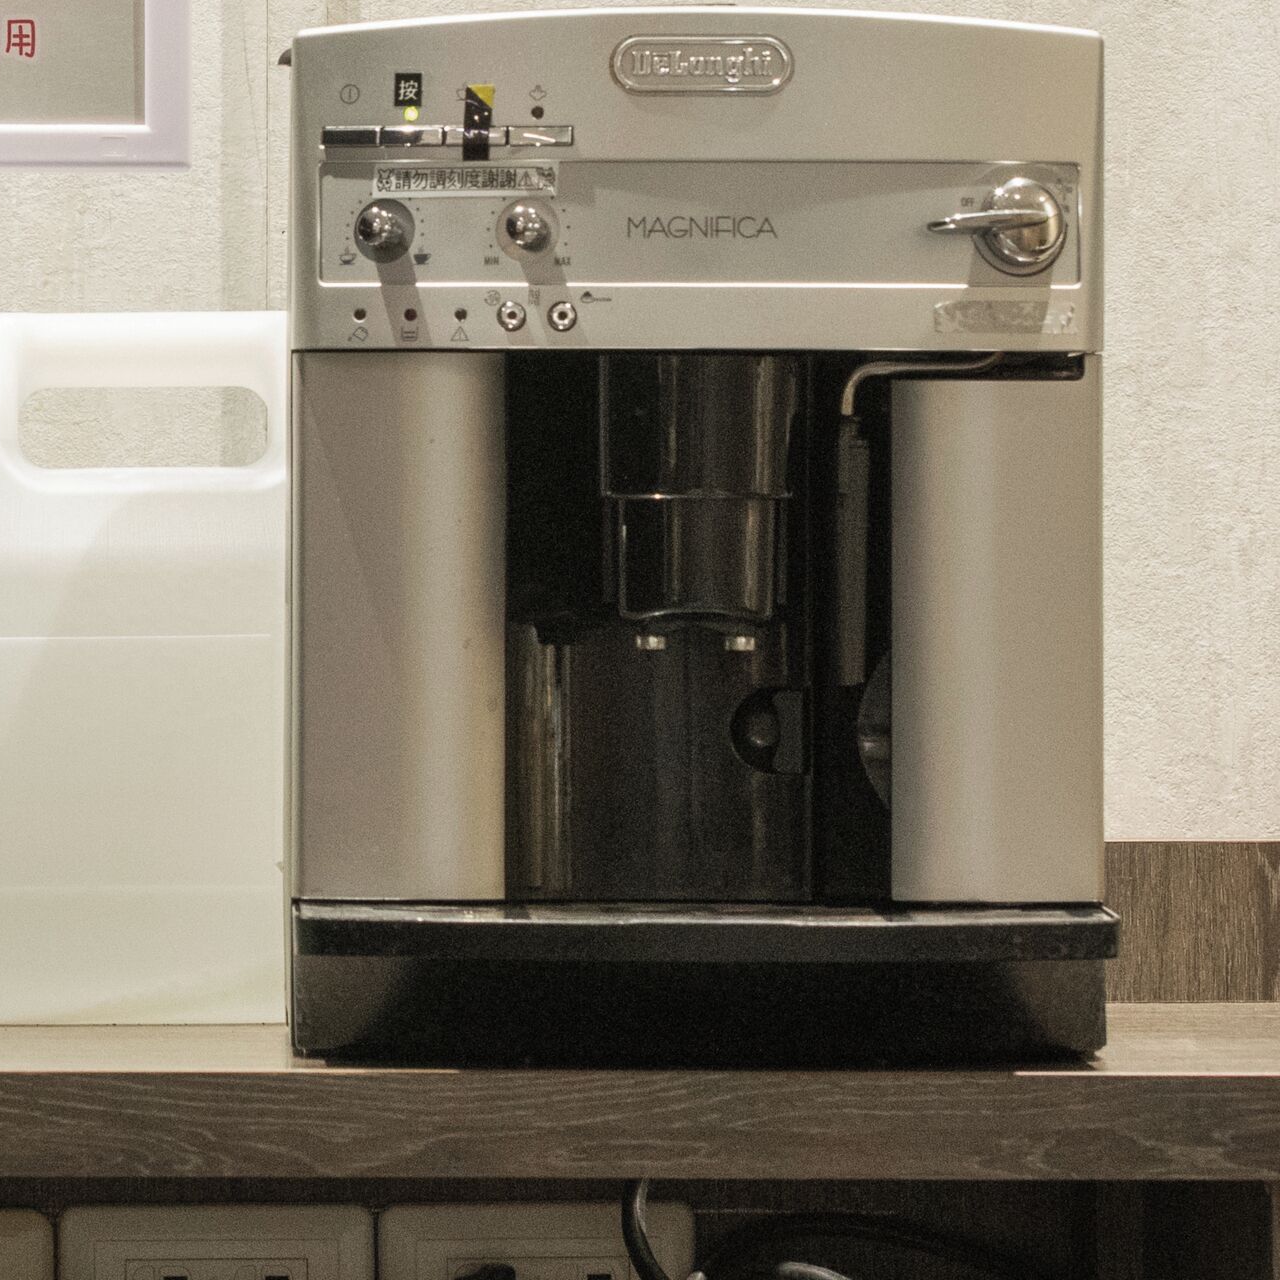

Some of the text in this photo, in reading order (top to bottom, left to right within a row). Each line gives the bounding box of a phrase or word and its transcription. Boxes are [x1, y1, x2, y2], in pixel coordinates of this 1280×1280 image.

[397, 79, 419, 101] 按
[394, 168, 518, 190] 請勿調刻度謝謝
[960, 196, 975, 208] OFF
[626, 215, 779, 240] MAGNIFICA
[483, 255, 500, 266] MIN
[553, 255, 572, 267] MAX
